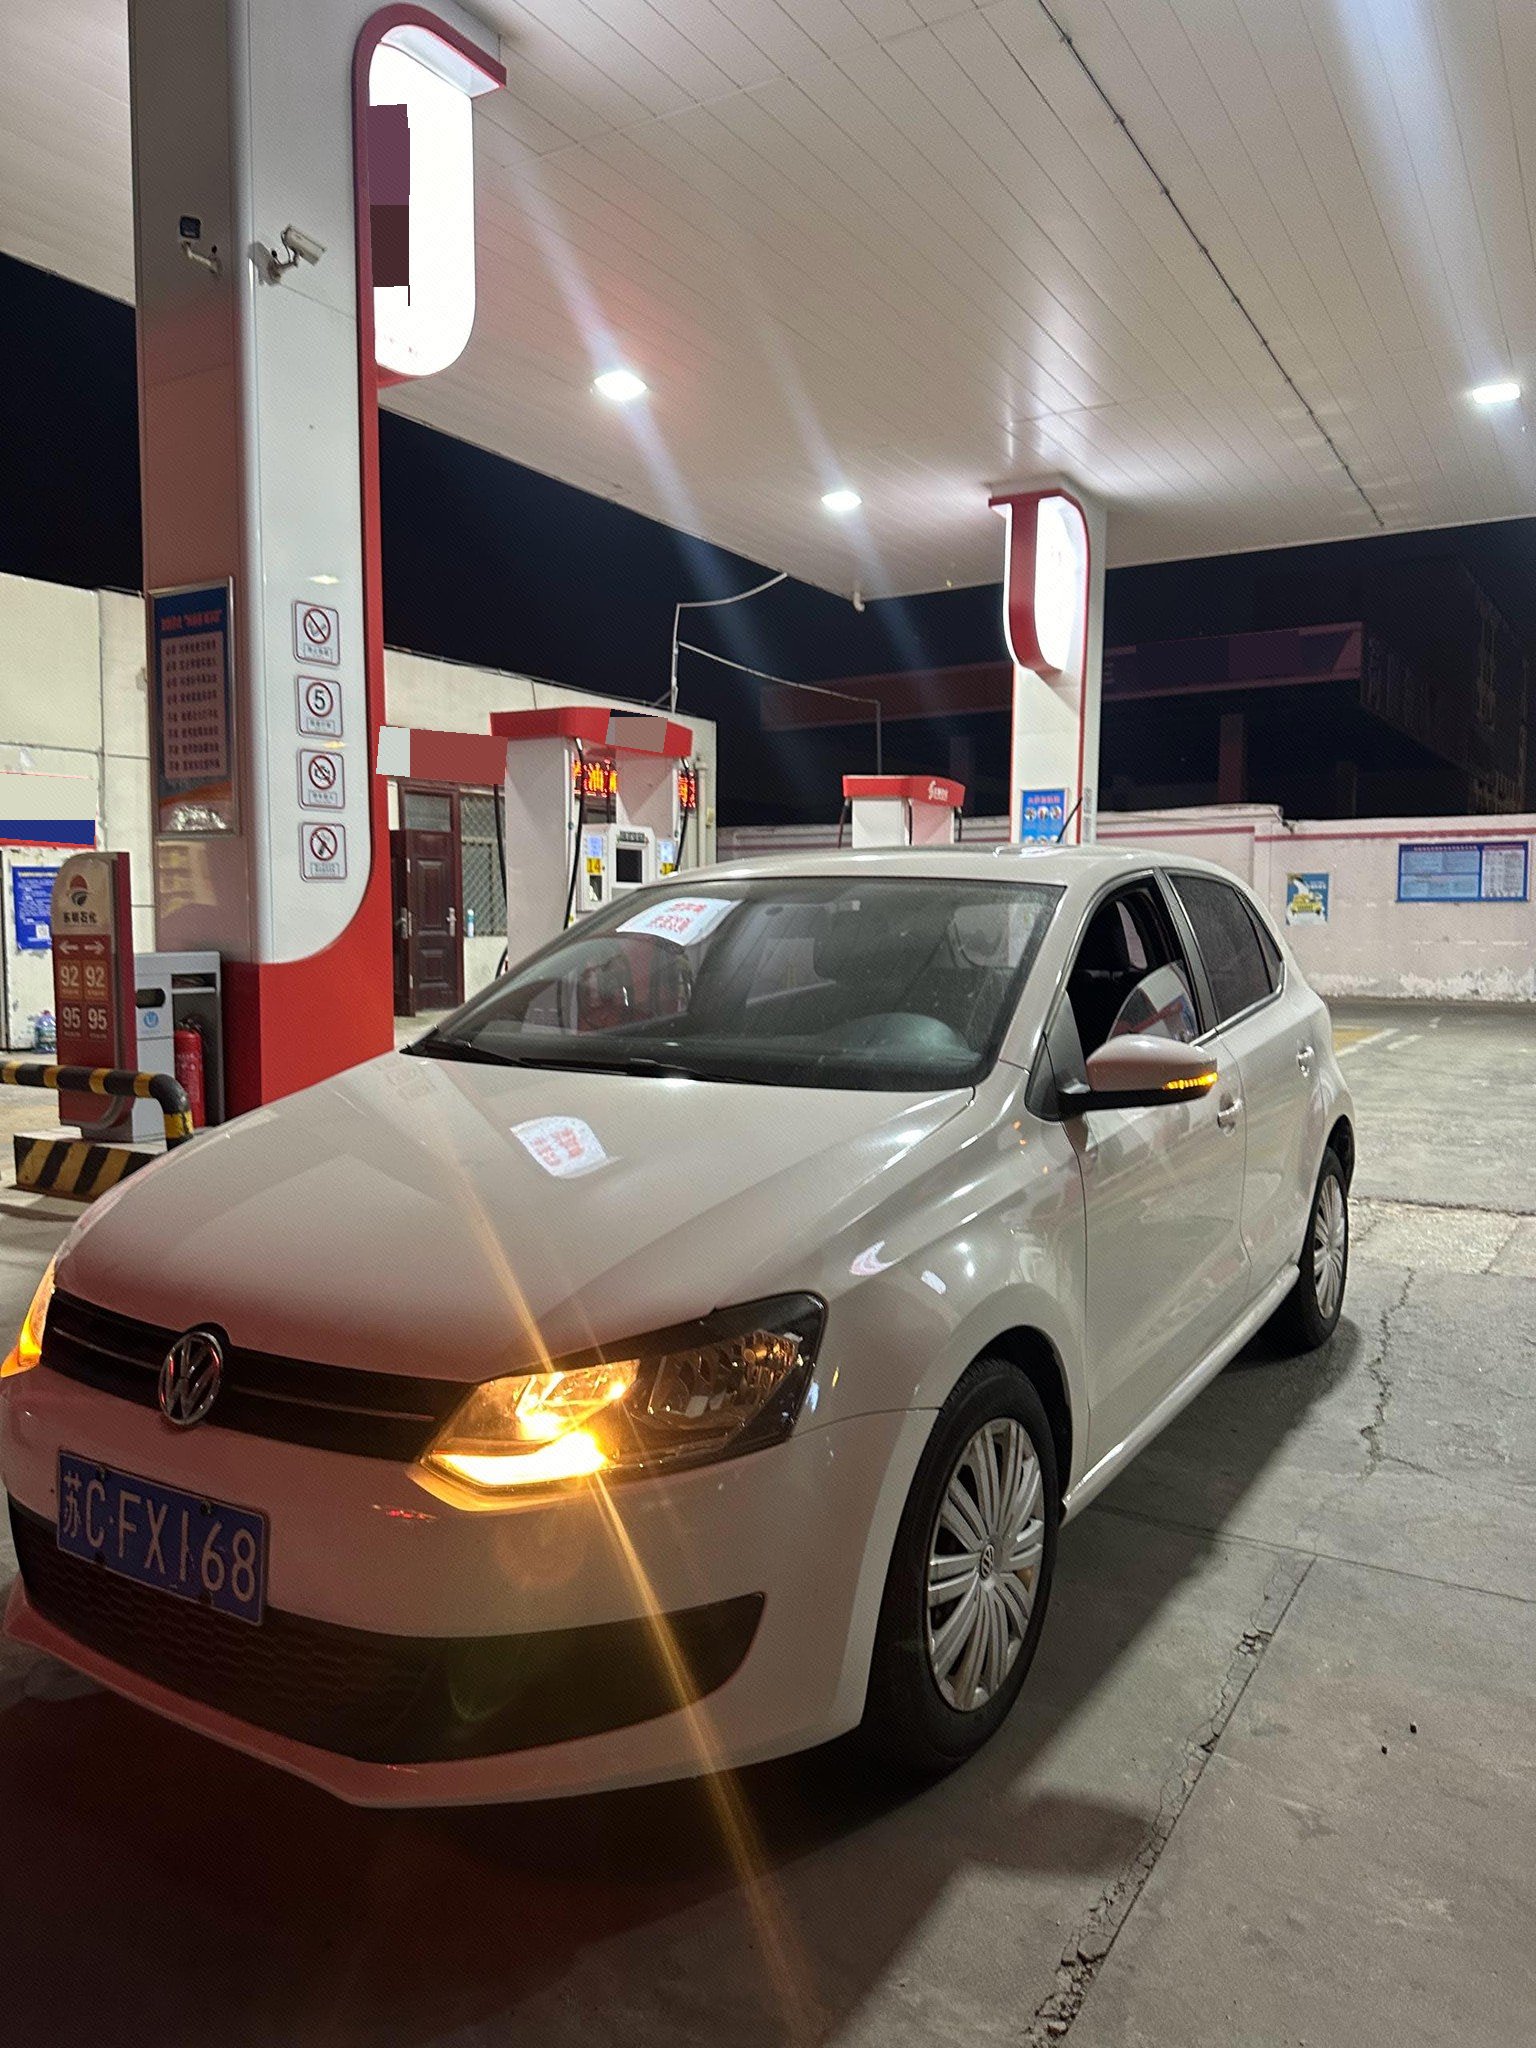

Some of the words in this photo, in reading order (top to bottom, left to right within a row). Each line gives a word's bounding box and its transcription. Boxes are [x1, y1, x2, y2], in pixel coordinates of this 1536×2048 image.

[314, 689, 326, 711] 5
[61, 965, 79, 988] 92
[86, 966, 105, 988] 92
[63, 1006, 81, 1028] 95
[88, 1008, 107, 1030] 95
